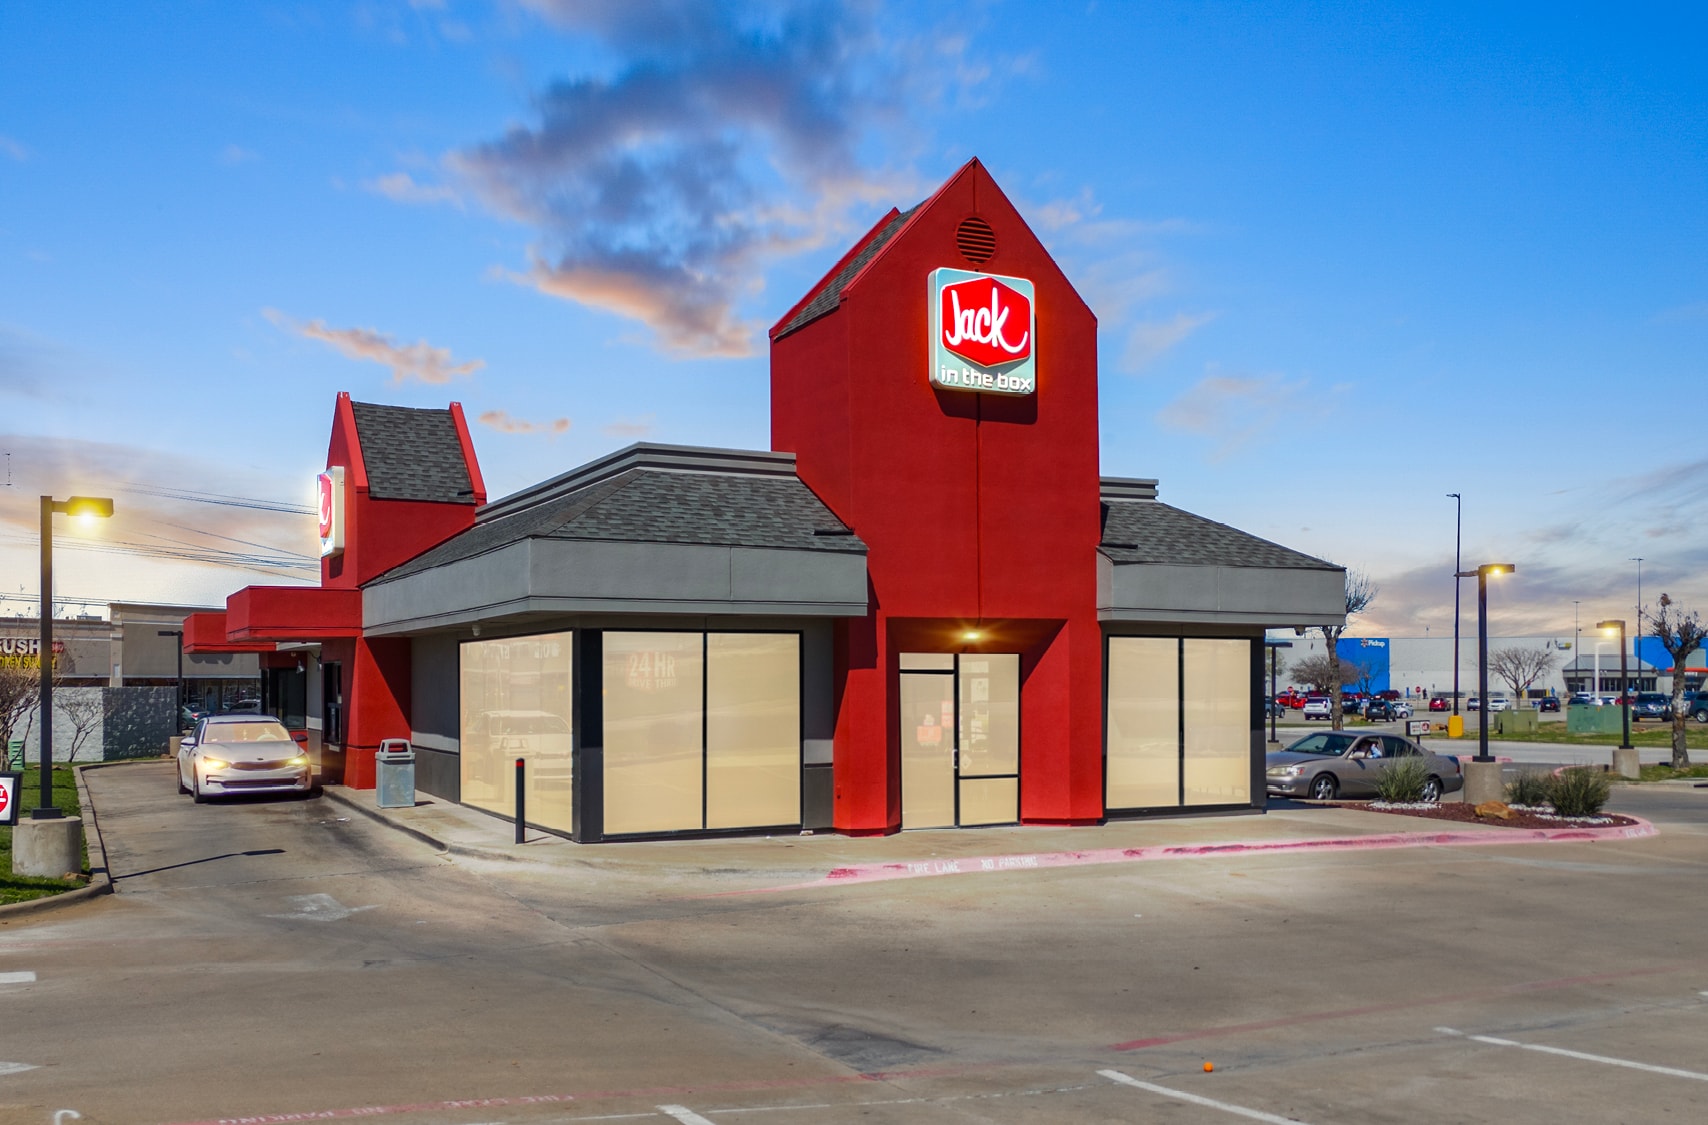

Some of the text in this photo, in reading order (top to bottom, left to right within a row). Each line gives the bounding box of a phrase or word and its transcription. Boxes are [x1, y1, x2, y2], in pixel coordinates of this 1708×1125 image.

[945, 287, 1028, 354] Jack
[941, 364, 1032, 391] in the box
[0, 639, 41, 654] USH
[629, 651, 676, 678] 24 HR
[935, 861, 961, 873] LANE
[998, 855, 1039, 868] PARKING
